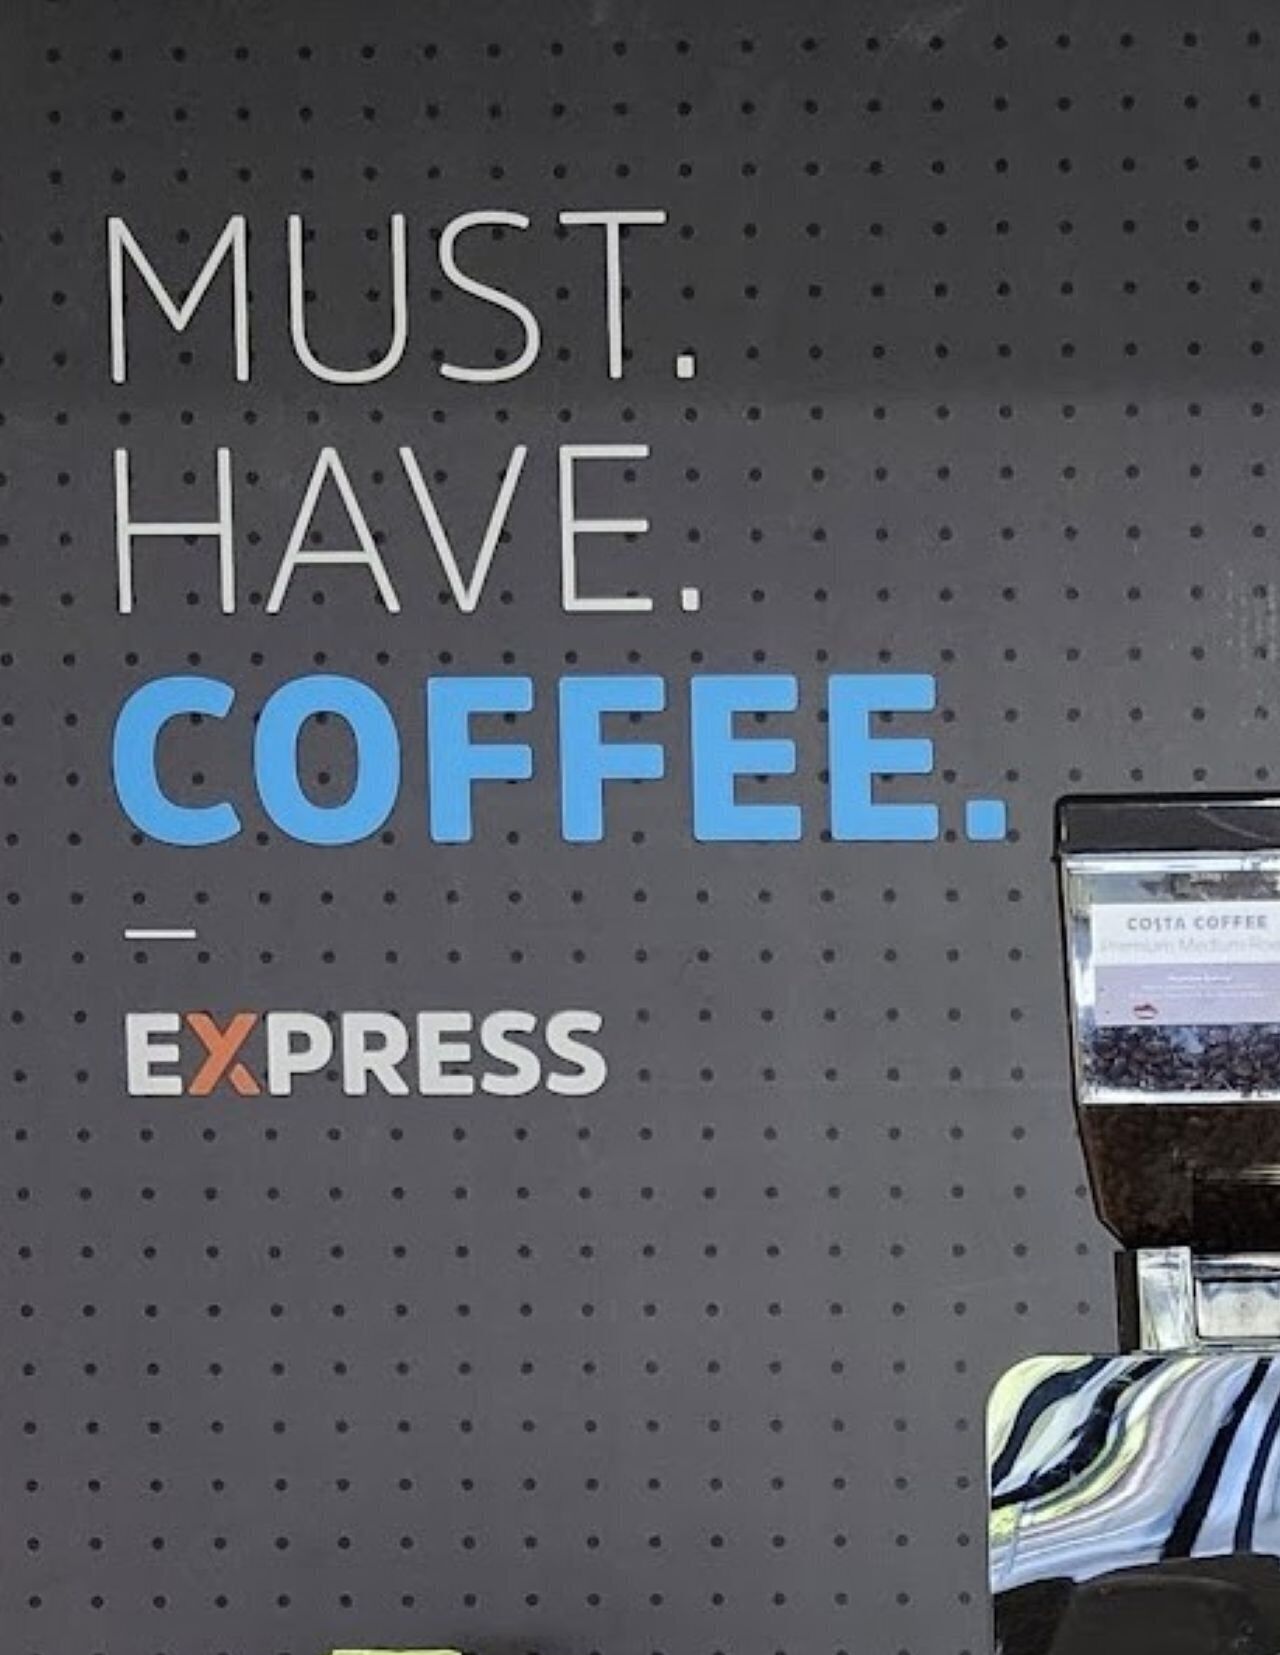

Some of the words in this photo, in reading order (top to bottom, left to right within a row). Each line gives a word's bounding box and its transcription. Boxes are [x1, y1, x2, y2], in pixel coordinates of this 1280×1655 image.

[106, 210, 696, 384] MUST.
[113, 442, 702, 615] HAVE.
[112, 672, 1008, 846] COFFEE.
[1127, 917, 1186, 933] COSTA
[1193, 915, 1268, 931] COFFEE
[124, 1008, 609, 1098] EXPRESS
